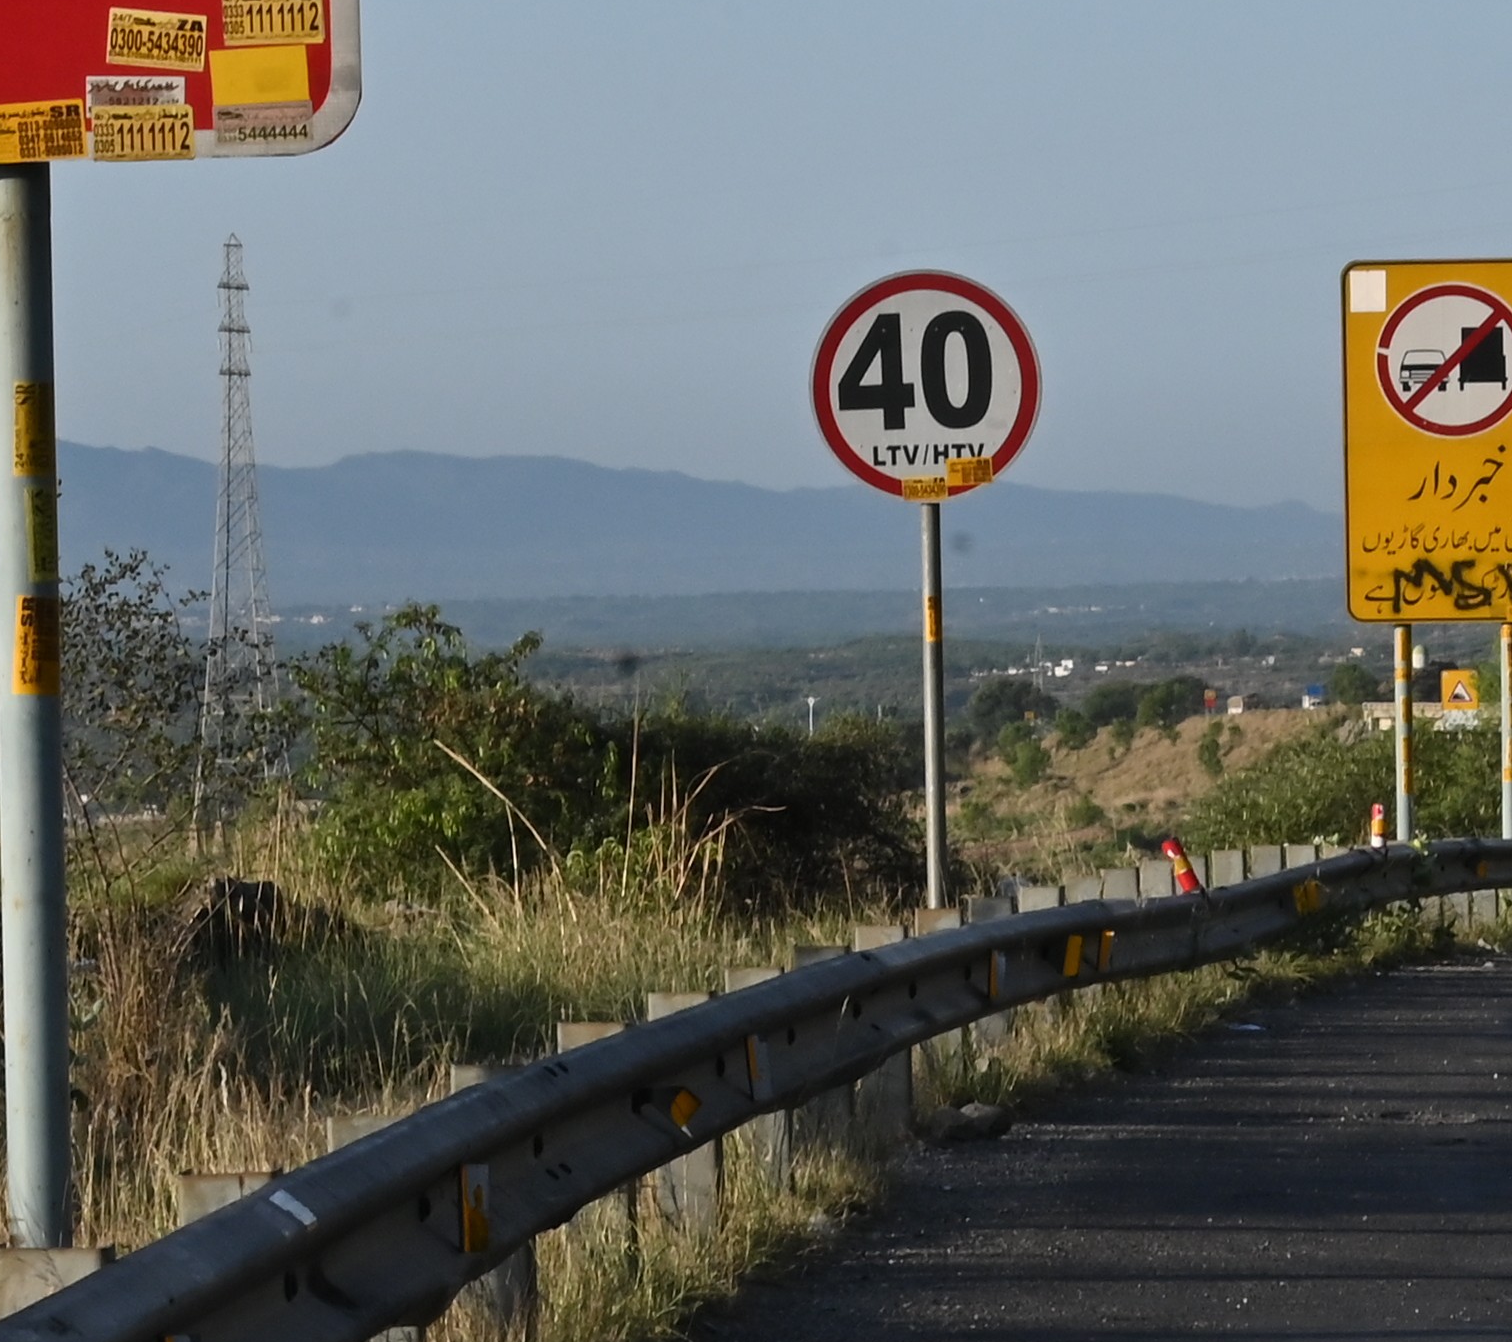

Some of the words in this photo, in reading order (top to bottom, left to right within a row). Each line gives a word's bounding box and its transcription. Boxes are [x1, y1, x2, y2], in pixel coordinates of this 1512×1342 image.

[224, 4, 244, 18] 0333
[177, 18, 204, 33] ZA
[111, 28, 203, 57] 0300-5434390
[50, 105, 80, 117] SR
[93, 123, 115, 137] 0333
[238, 124, 308, 141] 5444444
[94, 138, 115, 153] 0305
[838, 310, 992, 430] 40
[873, 443, 984, 466] LTV/HTV
[1408, 445, 1506, 511] خبردار
[1362, 524, 1424, 555] گاڑیوں
[1422, 524, 1472, 554] بھاری
[1473, 526, 1501, 553] میں
